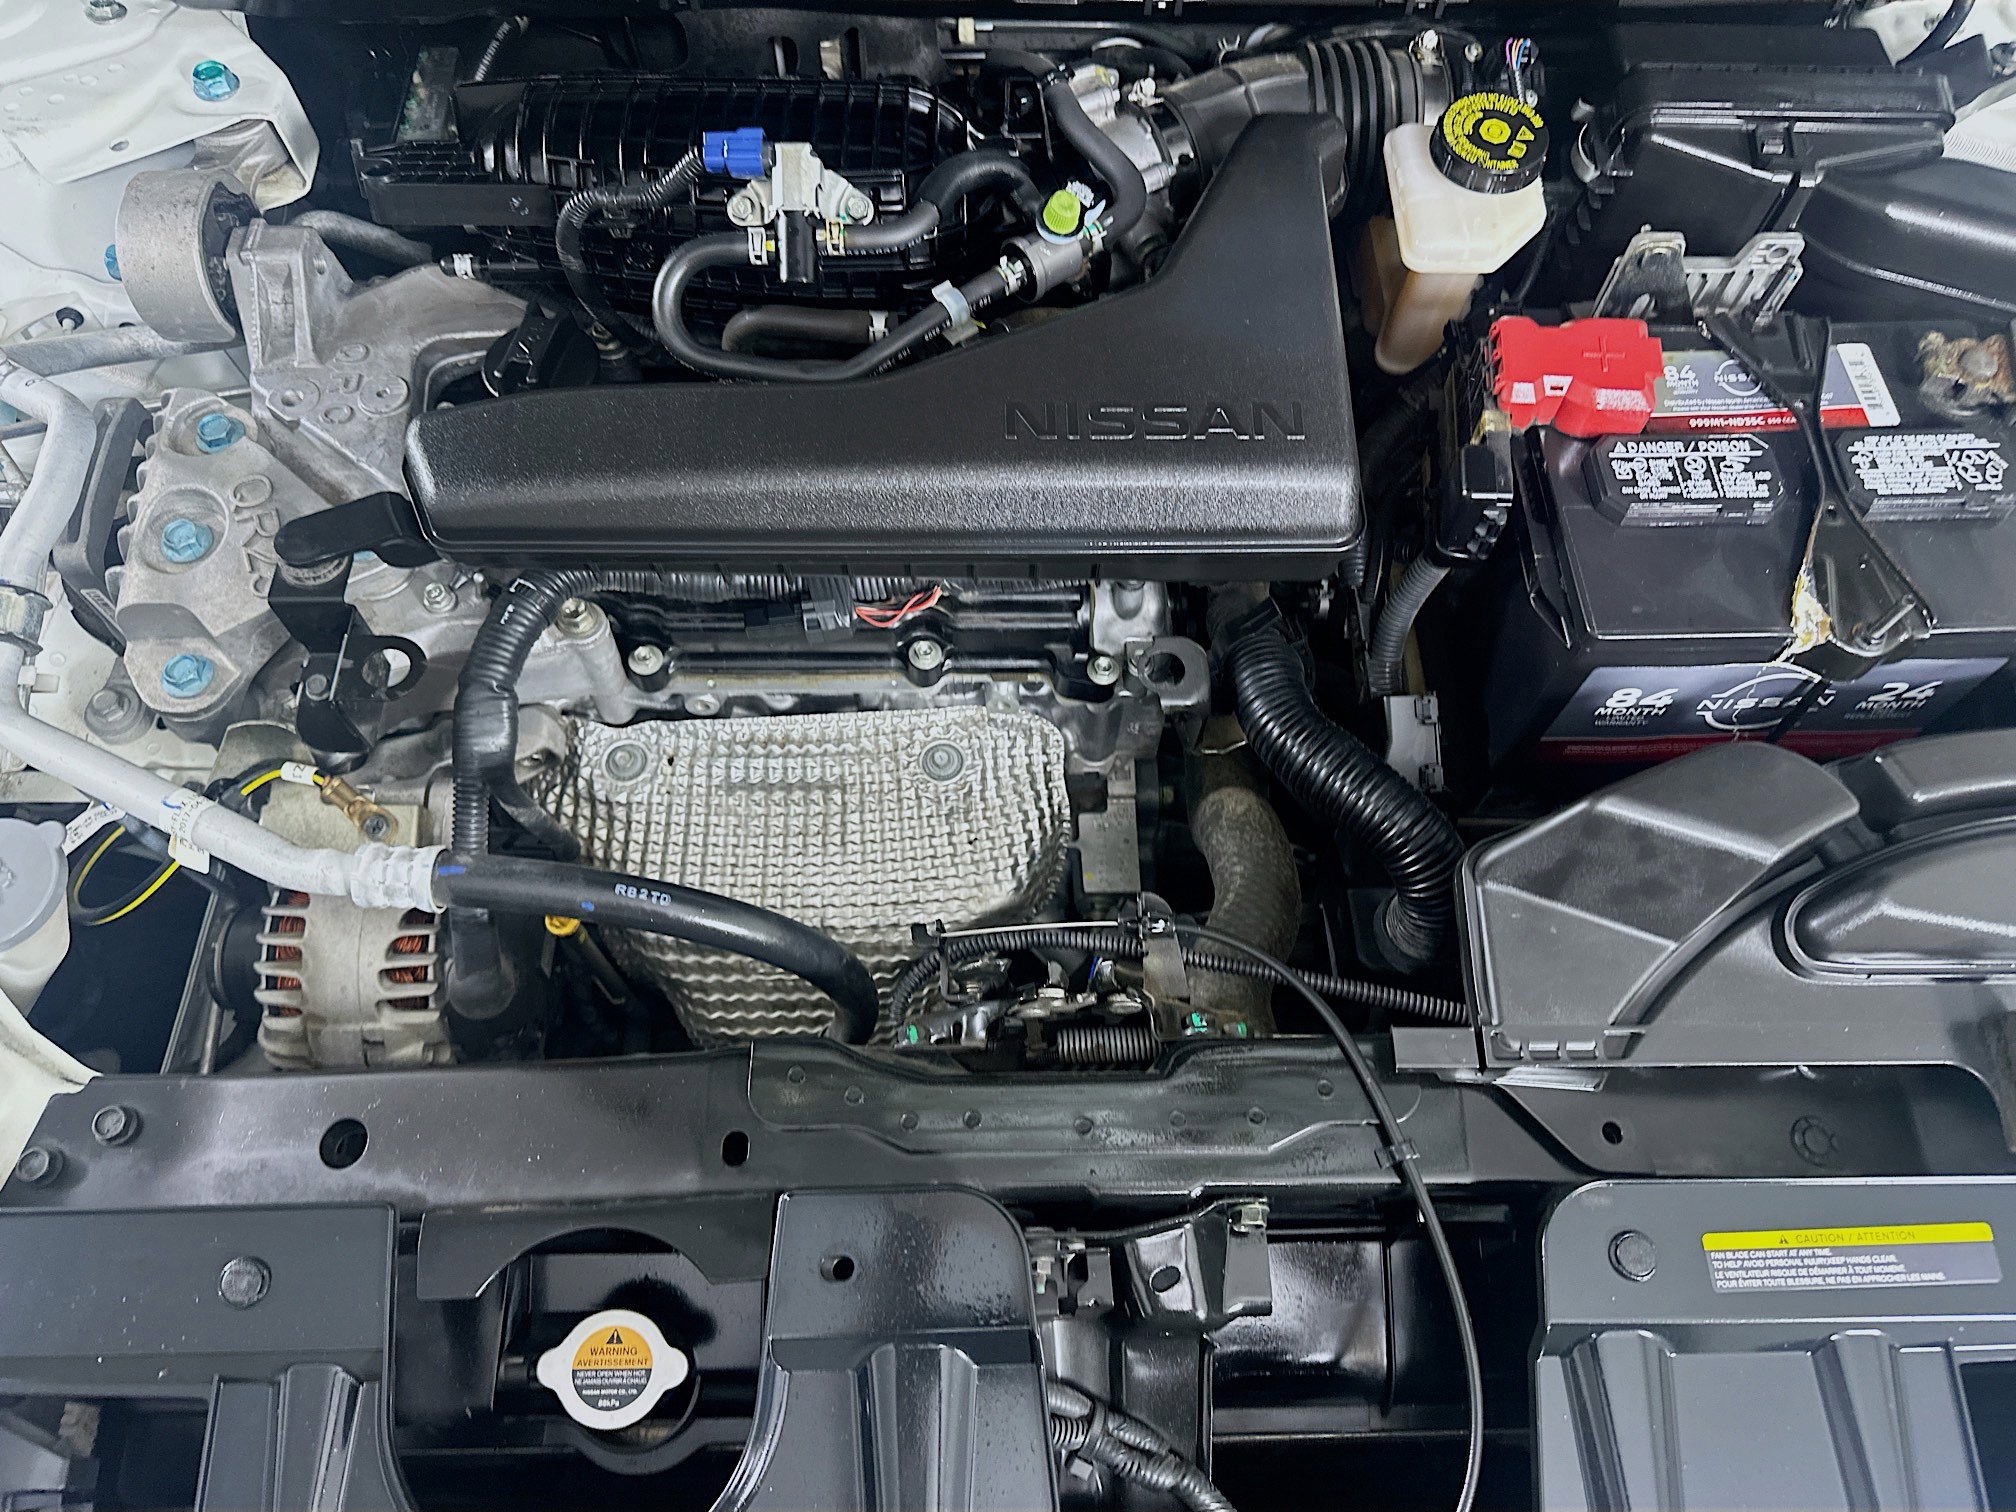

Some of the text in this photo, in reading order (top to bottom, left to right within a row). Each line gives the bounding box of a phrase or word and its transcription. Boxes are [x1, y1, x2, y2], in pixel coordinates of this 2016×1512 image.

[1663, 365, 1697, 381] 84
[1005, 402, 1305, 440] NISSAN
[1627, 441, 1685, 453] DANGER
[1698, 440, 1750, 452] POISON
[1605, 687, 1679, 708] 84
[1867, 680, 1944, 702] 24
[1594, 707, 1667, 716] MONTH
[1855, 700, 1927, 711] MONTH
[1795, 1234, 1844, 1244] CAUTION
[1857, 1230, 1916, 1241] ATTENTION
[1711, 1251, 1725, 1259] FAN
[1726, 1251, 1749, 1259] BLADE
[1750, 1250, 1766, 1258] CAN
[1766, 1250, 1787, 1258] START
[1789, 1249, 1798, 1257] AT
[1799, 1248, 1813, 1256] ANY
[1713, 1261, 1723, 1269] TO
[1724, 1260, 1742, 1268] HELP
[1743, 1259, 1765, 1267] AVOID
[1765, 1258, 1803, 1267] PERSONAL
[1846, 1255, 1871, 1264] HANDS
[1715, 1271, 1724, 1279] LE
[1725, 1269, 1770, 1278] VENTILATEUR
[1770, 1268, 1797, 1277] RISQUE
[1798, 1268, 1808, 1276] DE
[1809, 1266, 1847, 1276] DÉMARRER
[1848, 1265, 1854, 1274] À
[1854, 1265, 1873, 1273] TOUT
[1717, 1280, 1738, 1288] POUR
[1738, 1278, 1762, 1288] ÉVITER
[1763, 1278, 1786, 1287] TOUTE
[1826, 1276, 1836, 1284] NE
[1837, 1275, 1851, 1284] PAS
[1852, 1275, 1863, 1283] EN
[1863, 1274, 1907, 1283] APPROCHER
[1907, 1273, 1920, 1281] LES
[590, 1346, 638, 1356] WARNING
[577, 1358, 648, 1367] AVERTISSEMENT
[602, 1377, 622, 1385] OUVRIR
